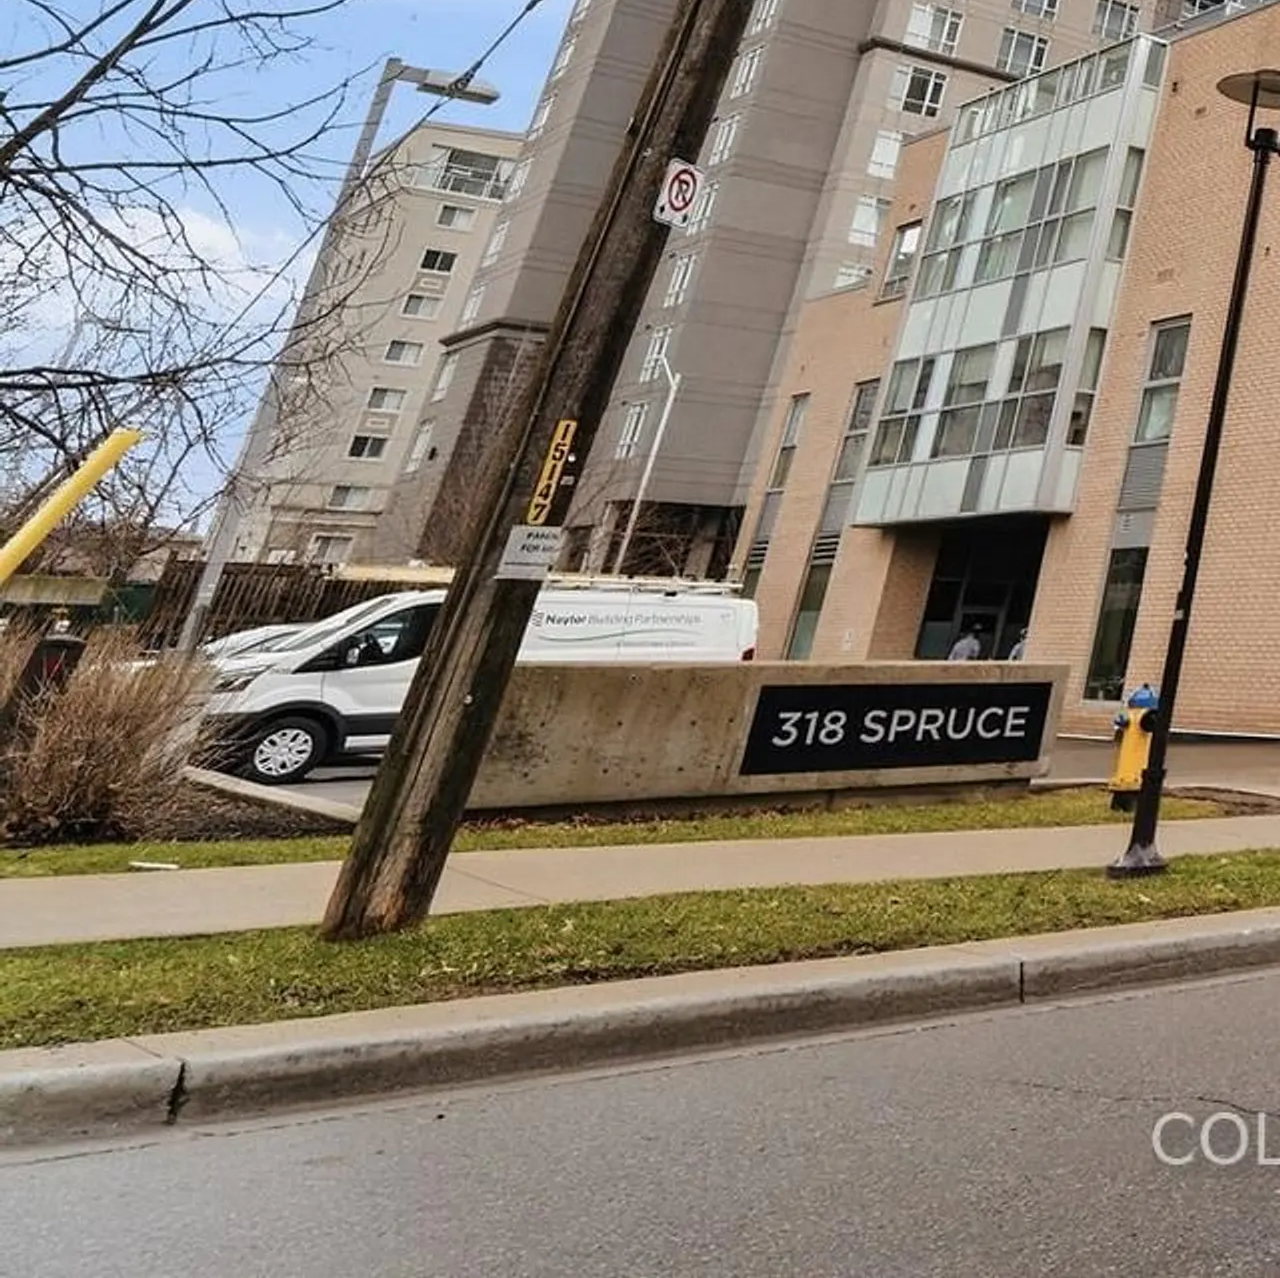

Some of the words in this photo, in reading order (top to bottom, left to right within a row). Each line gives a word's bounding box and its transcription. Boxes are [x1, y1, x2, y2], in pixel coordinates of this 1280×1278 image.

[532, 423, 571, 521] 15147
[771, 710, 847, 747] 318
[859, 706, 1030, 743] SPRUCE
